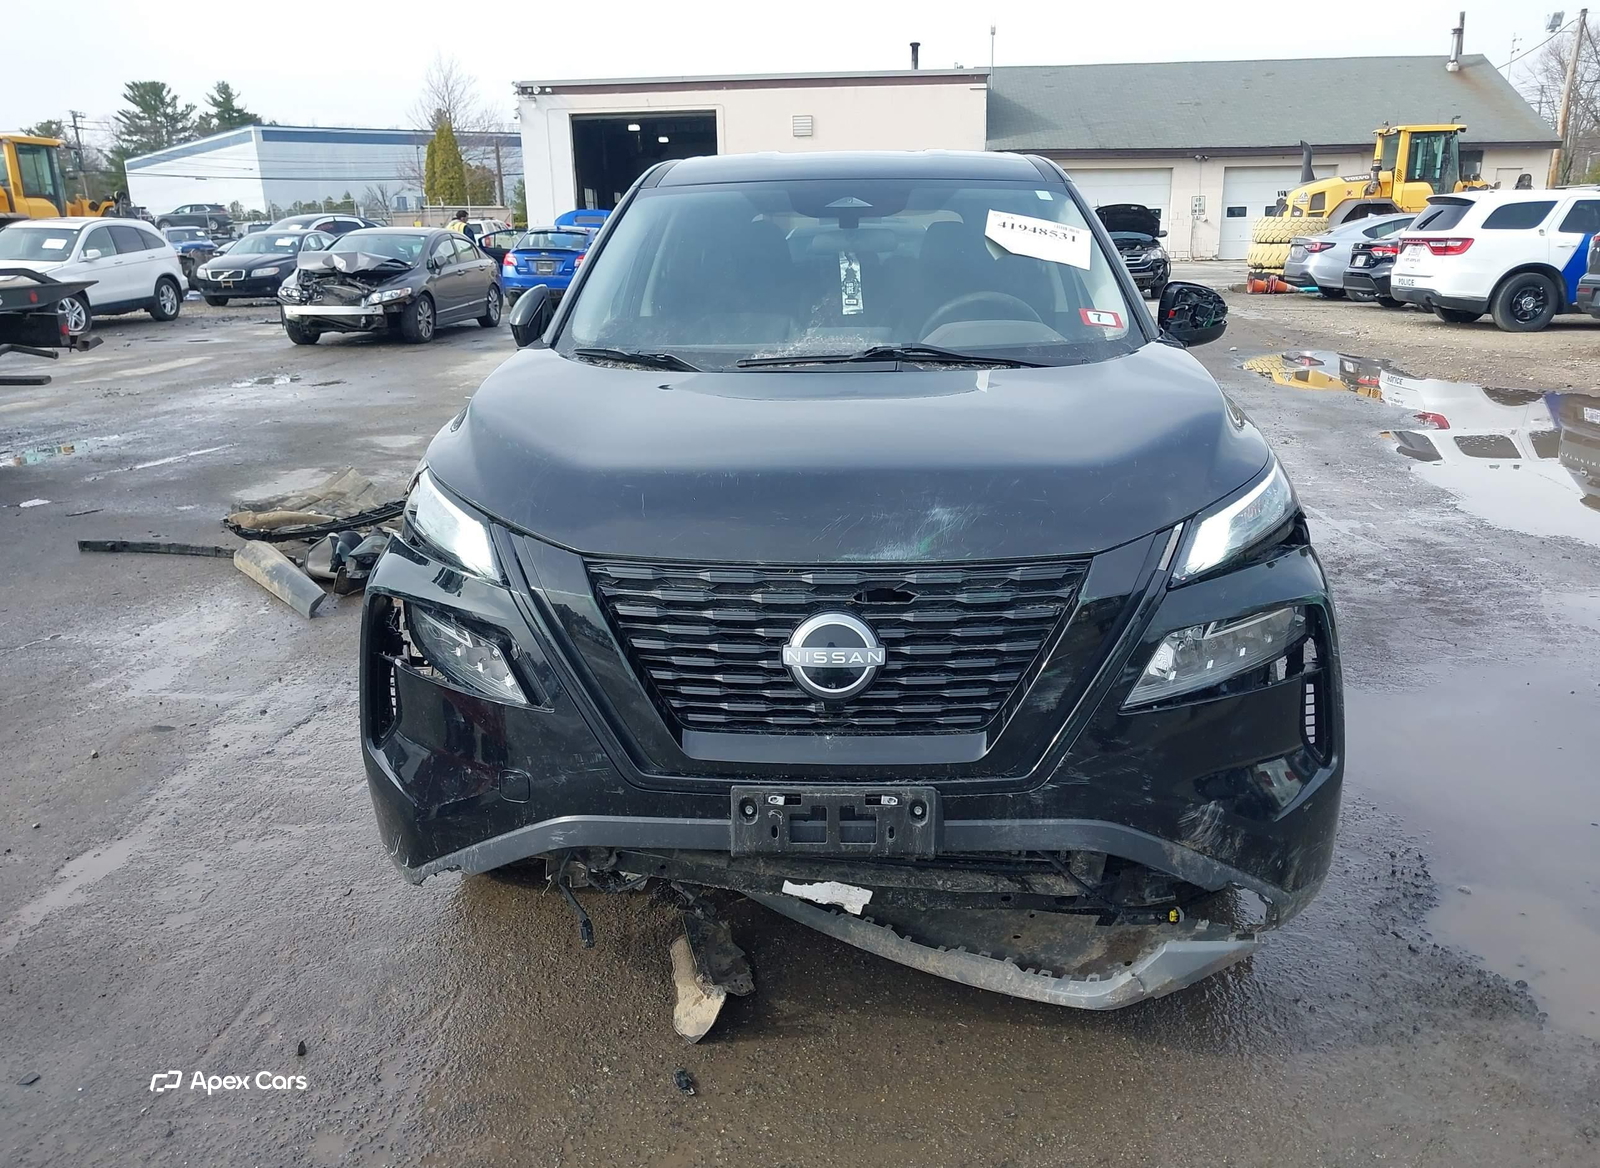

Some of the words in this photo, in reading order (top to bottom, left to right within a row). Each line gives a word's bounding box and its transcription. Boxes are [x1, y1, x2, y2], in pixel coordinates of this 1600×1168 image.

[998, 221, 1076, 242] 41948531
[1398, 278, 1415, 286] POLICE
[1093, 313, 1102, 322] 7
[786, 650, 882, 664] NISSAN
